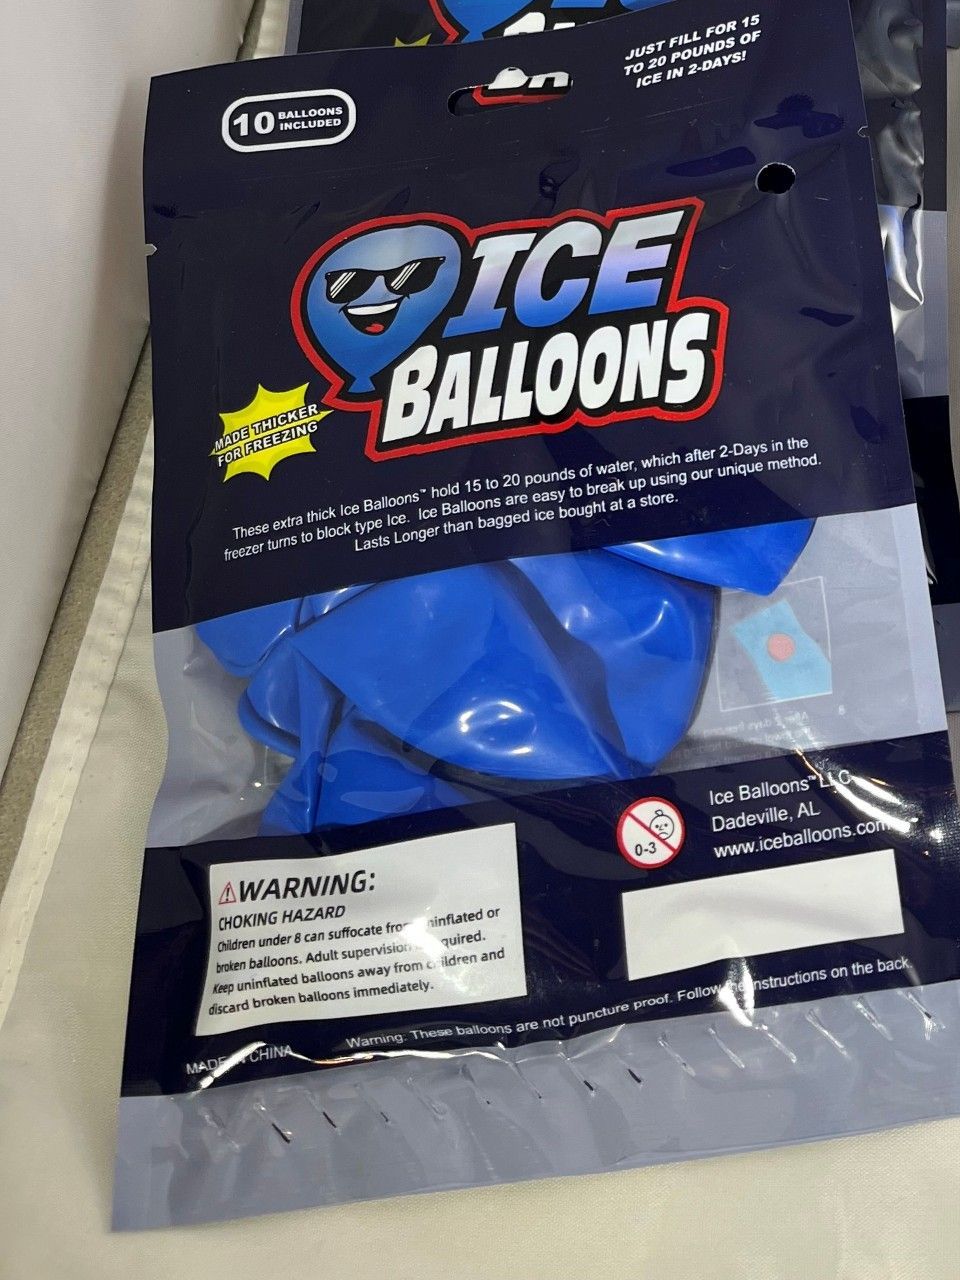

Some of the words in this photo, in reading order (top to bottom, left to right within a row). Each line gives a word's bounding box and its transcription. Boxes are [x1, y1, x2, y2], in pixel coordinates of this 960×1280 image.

[623, 61, 645, 76] TO
[647, 55, 667, 70] 20
[670, 36, 736, 64] POUNDS
[739, 29, 762, 45] OF
[624, 40, 666, 61] JUST
[668, 30, 702, 49] FILL
[705, 20, 737, 38] FOR
[741, 14, 760, 28] 15
[636, 71, 663, 89] ICE
[666, 66, 684, 81] IN
[687, 50, 747, 76] 2-DAYS!
[233, 113, 276, 137] 10
[279, 107, 344, 120] BALLOONS
[279, 118, 342, 132] INCLUDED
[441, 210, 685, 339] ICE
[382, 312, 710, 443] BALLOONS
[215, 430, 250, 451] MADE
[251, 404, 319, 437] THICKER
[217, 447, 243, 467] FOR
[244, 421, 319, 455] FREEZING
[354, 535, 391, 552] Lasts
[394, 526, 440, 544] Longer
[443, 520, 474, 535] than
[477, 509, 531, 529] bagged
[534, 508, 555, 521] ice
[558, 500, 607, 519] bought
[609, 498, 624, 512] at
[627, 498, 636, 509] a
[639, 493, 679, 507] store.
[238, 869, 377, 904] WARNING:
[218, 910, 278, 932] CHOKING
[281, 905, 346, 924] HAZARD
